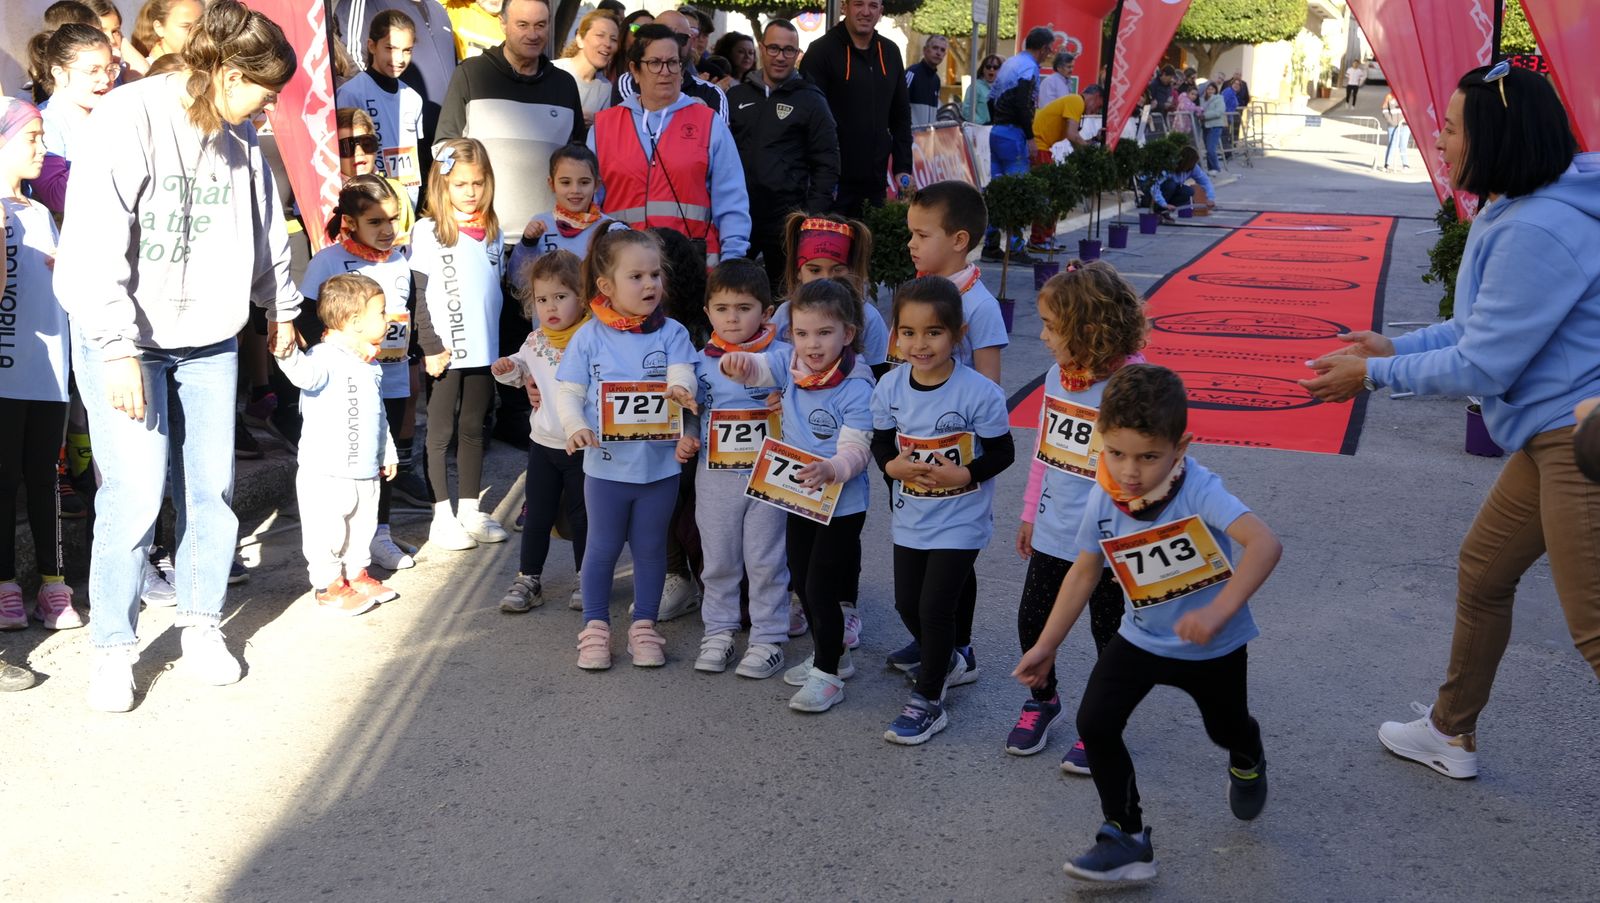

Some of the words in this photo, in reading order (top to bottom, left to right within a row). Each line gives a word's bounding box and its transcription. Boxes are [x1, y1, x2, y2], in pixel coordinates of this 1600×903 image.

[389, 156, 412, 171] 711
[141, 211, 155, 230] a
[139, 237, 165, 261] to
[441, 254, 467, 360] POLVORILLA
[386, 325, 407, 341] 24
[614, 395, 665, 414] 727
[1190, 391, 1291, 406] LVORA
[718, 422, 767, 442] 721
[1049, 412, 1092, 445] 748
[1125, 538, 1196, 575] 713
